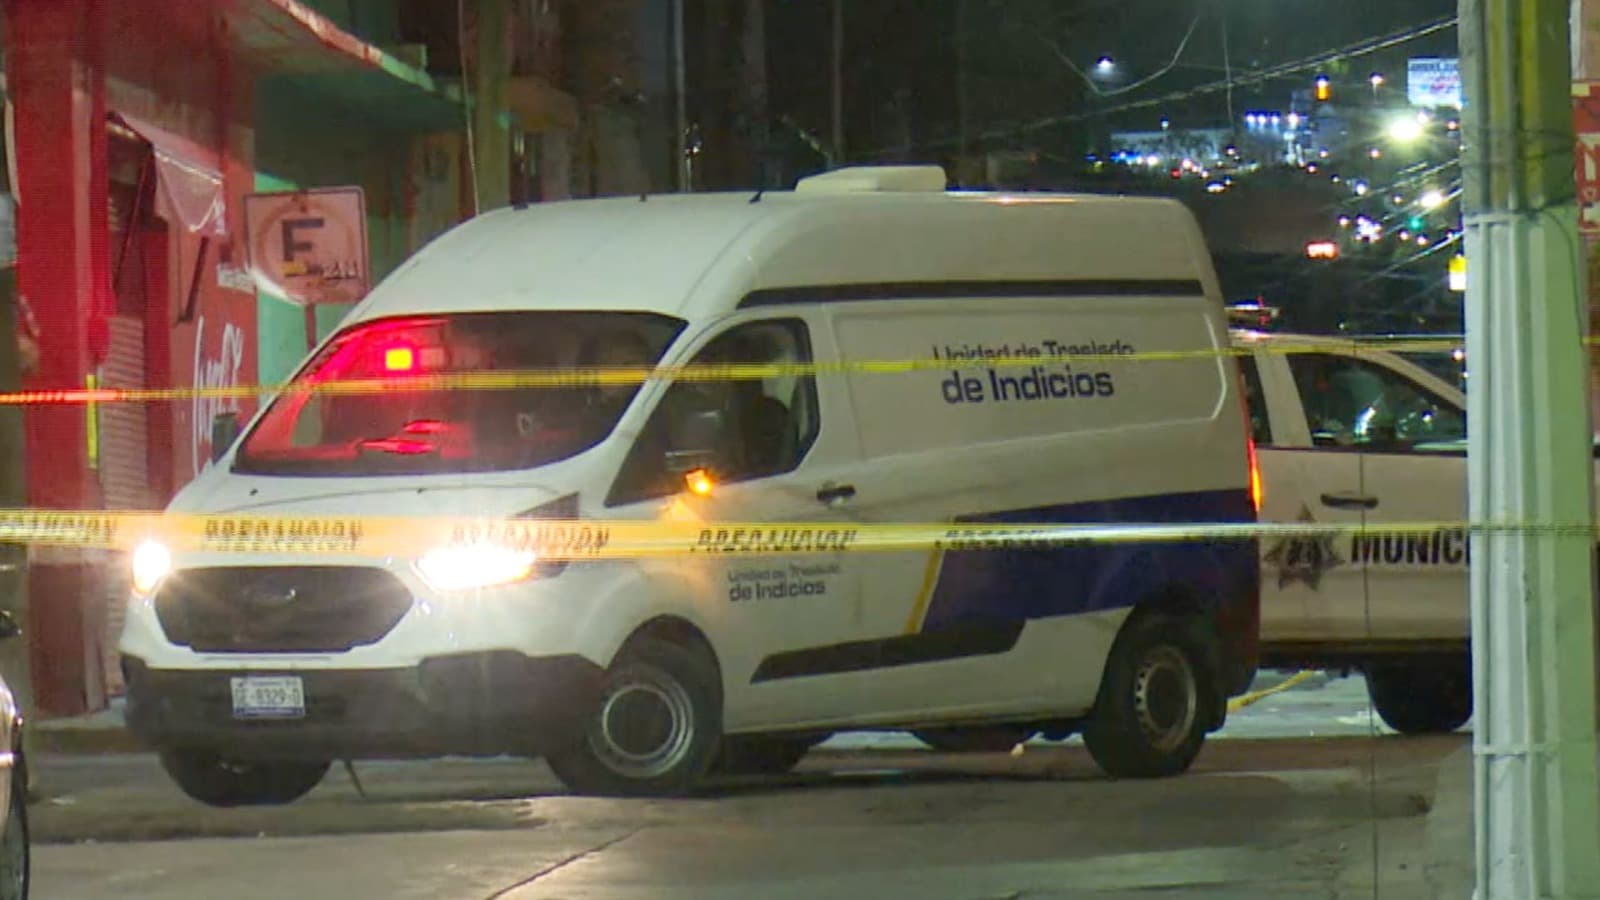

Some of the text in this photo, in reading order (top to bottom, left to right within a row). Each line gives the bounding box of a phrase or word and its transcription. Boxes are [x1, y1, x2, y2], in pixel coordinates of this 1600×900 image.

[942, 364, 1115, 404] de Indicios
[729, 579, 826, 602] de Indicios
